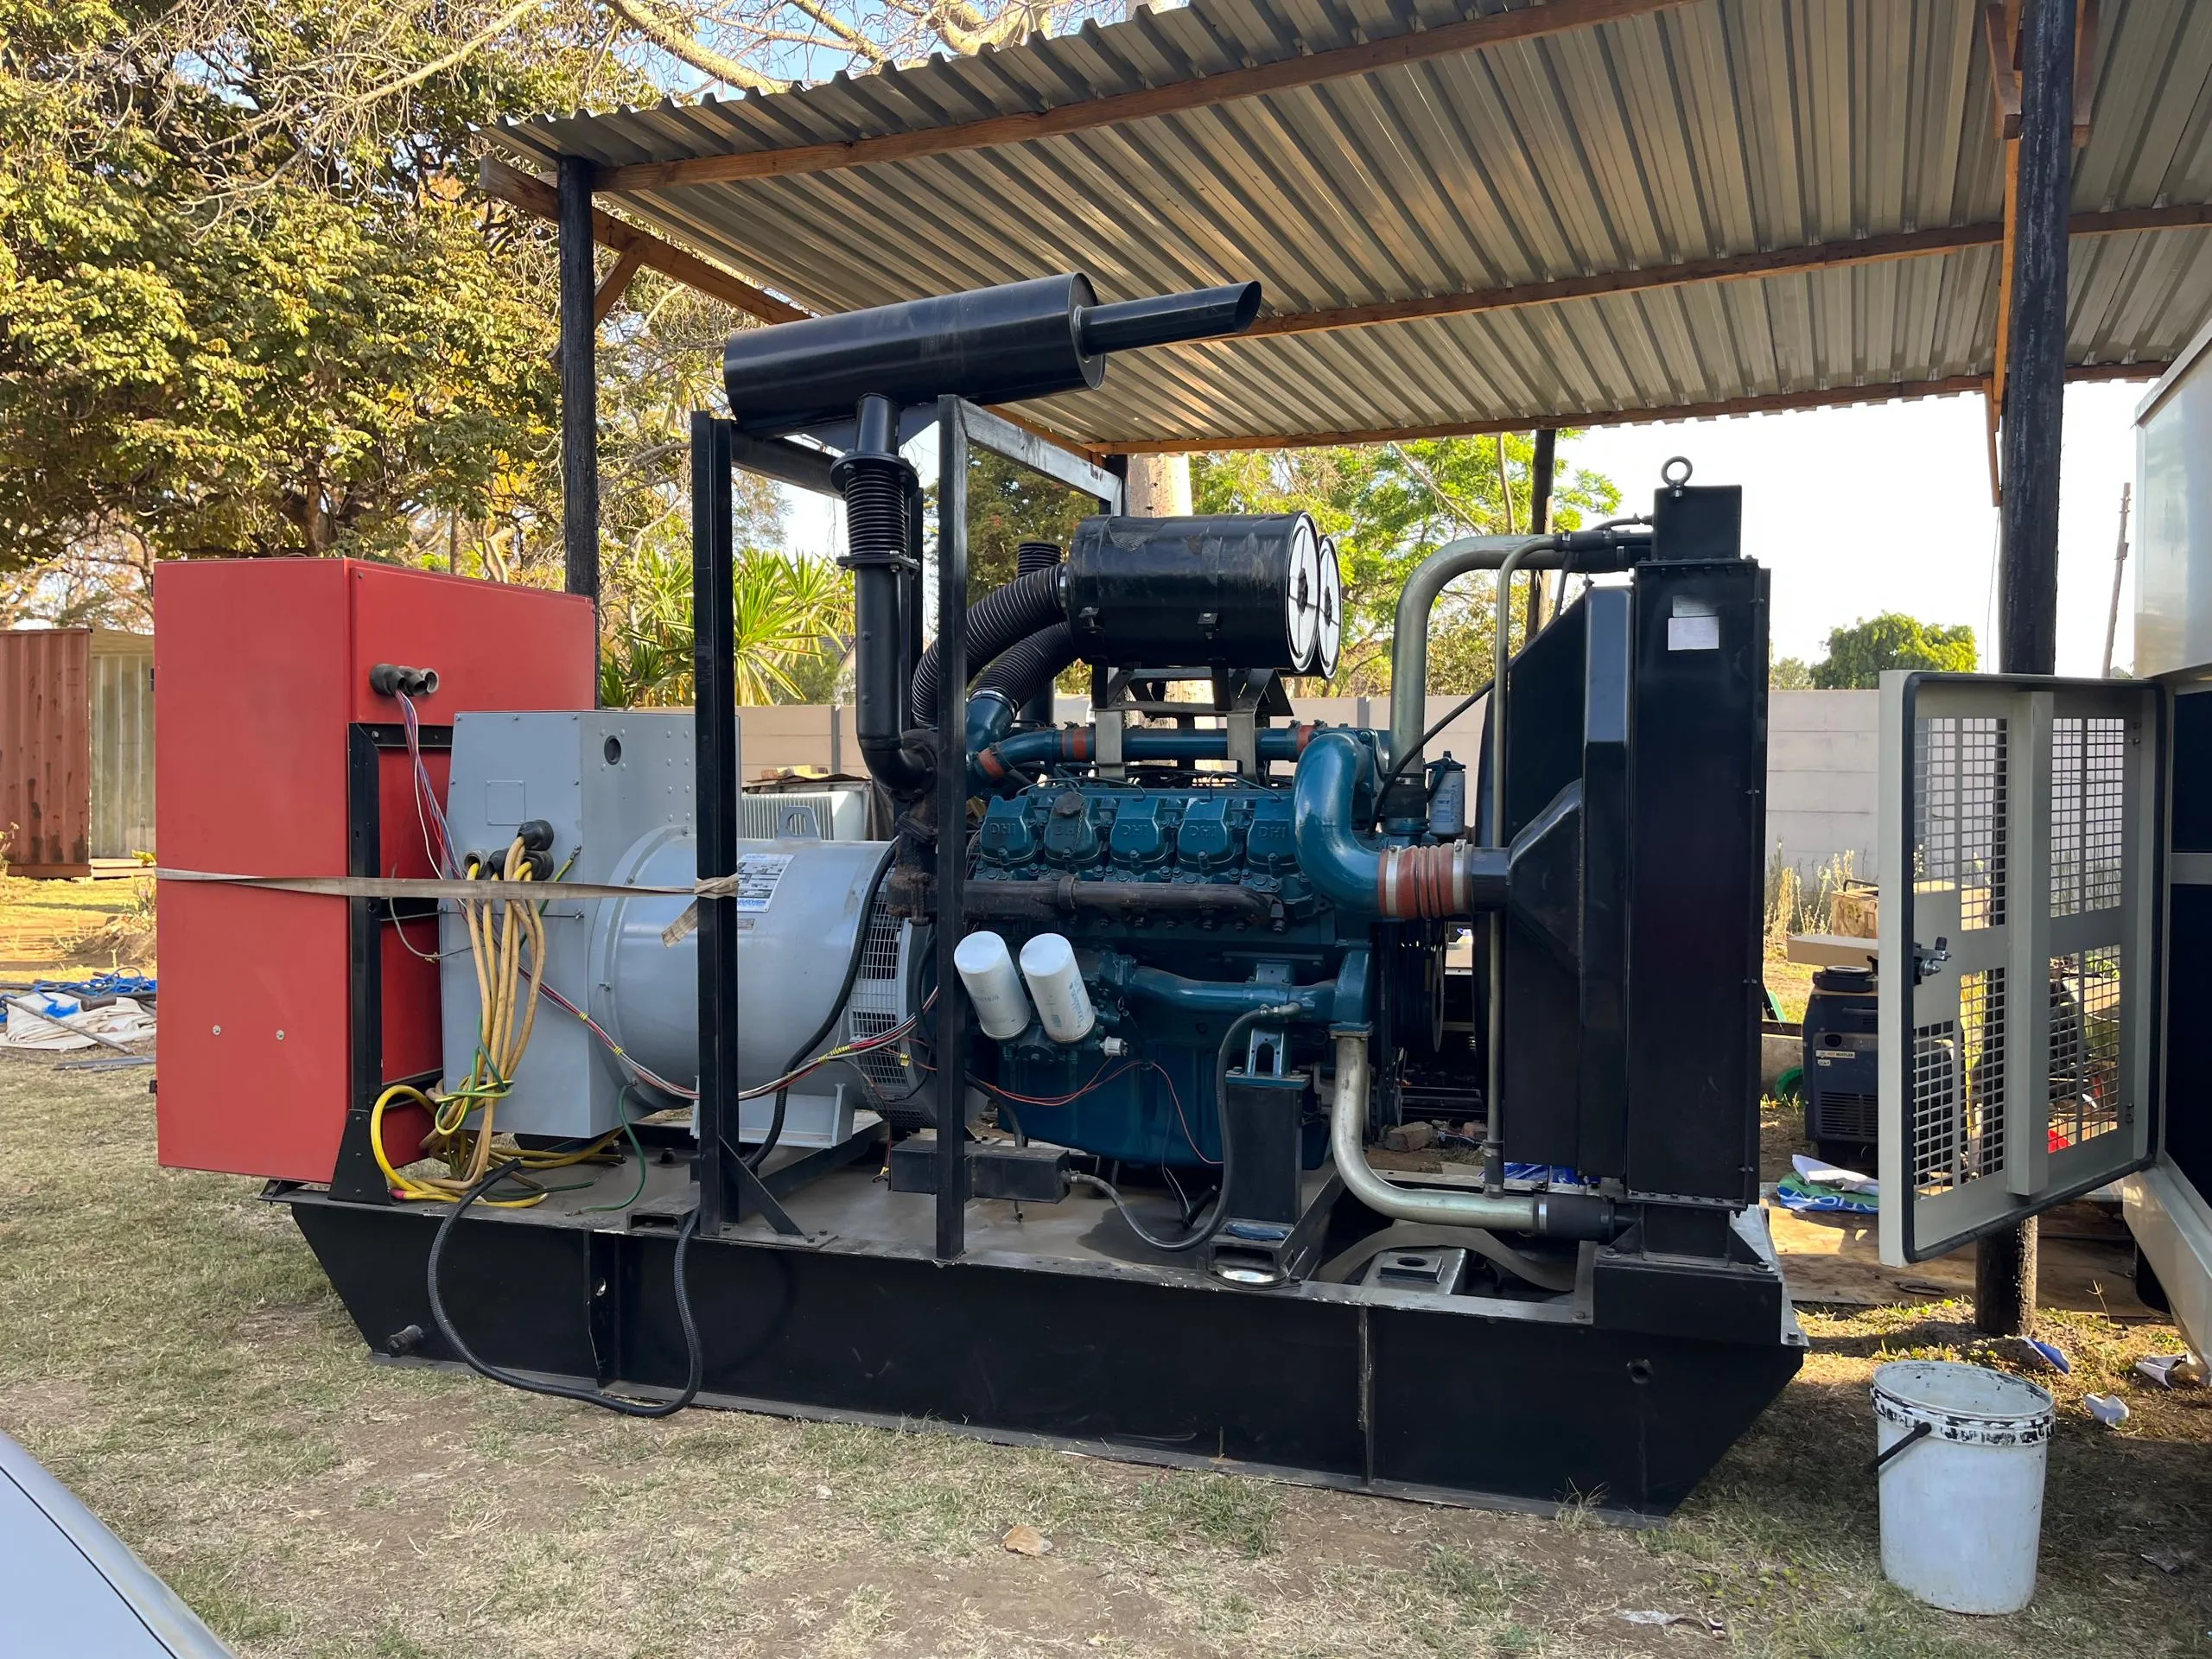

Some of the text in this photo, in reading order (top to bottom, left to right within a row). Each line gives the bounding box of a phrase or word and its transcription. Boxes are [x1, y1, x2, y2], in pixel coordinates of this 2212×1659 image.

[990, 823, 1016, 836] DHI
[1121, 824, 1148, 836] DHI
[1188, 825, 1217, 838] DHI
[1258, 826, 1286, 839] DHI
